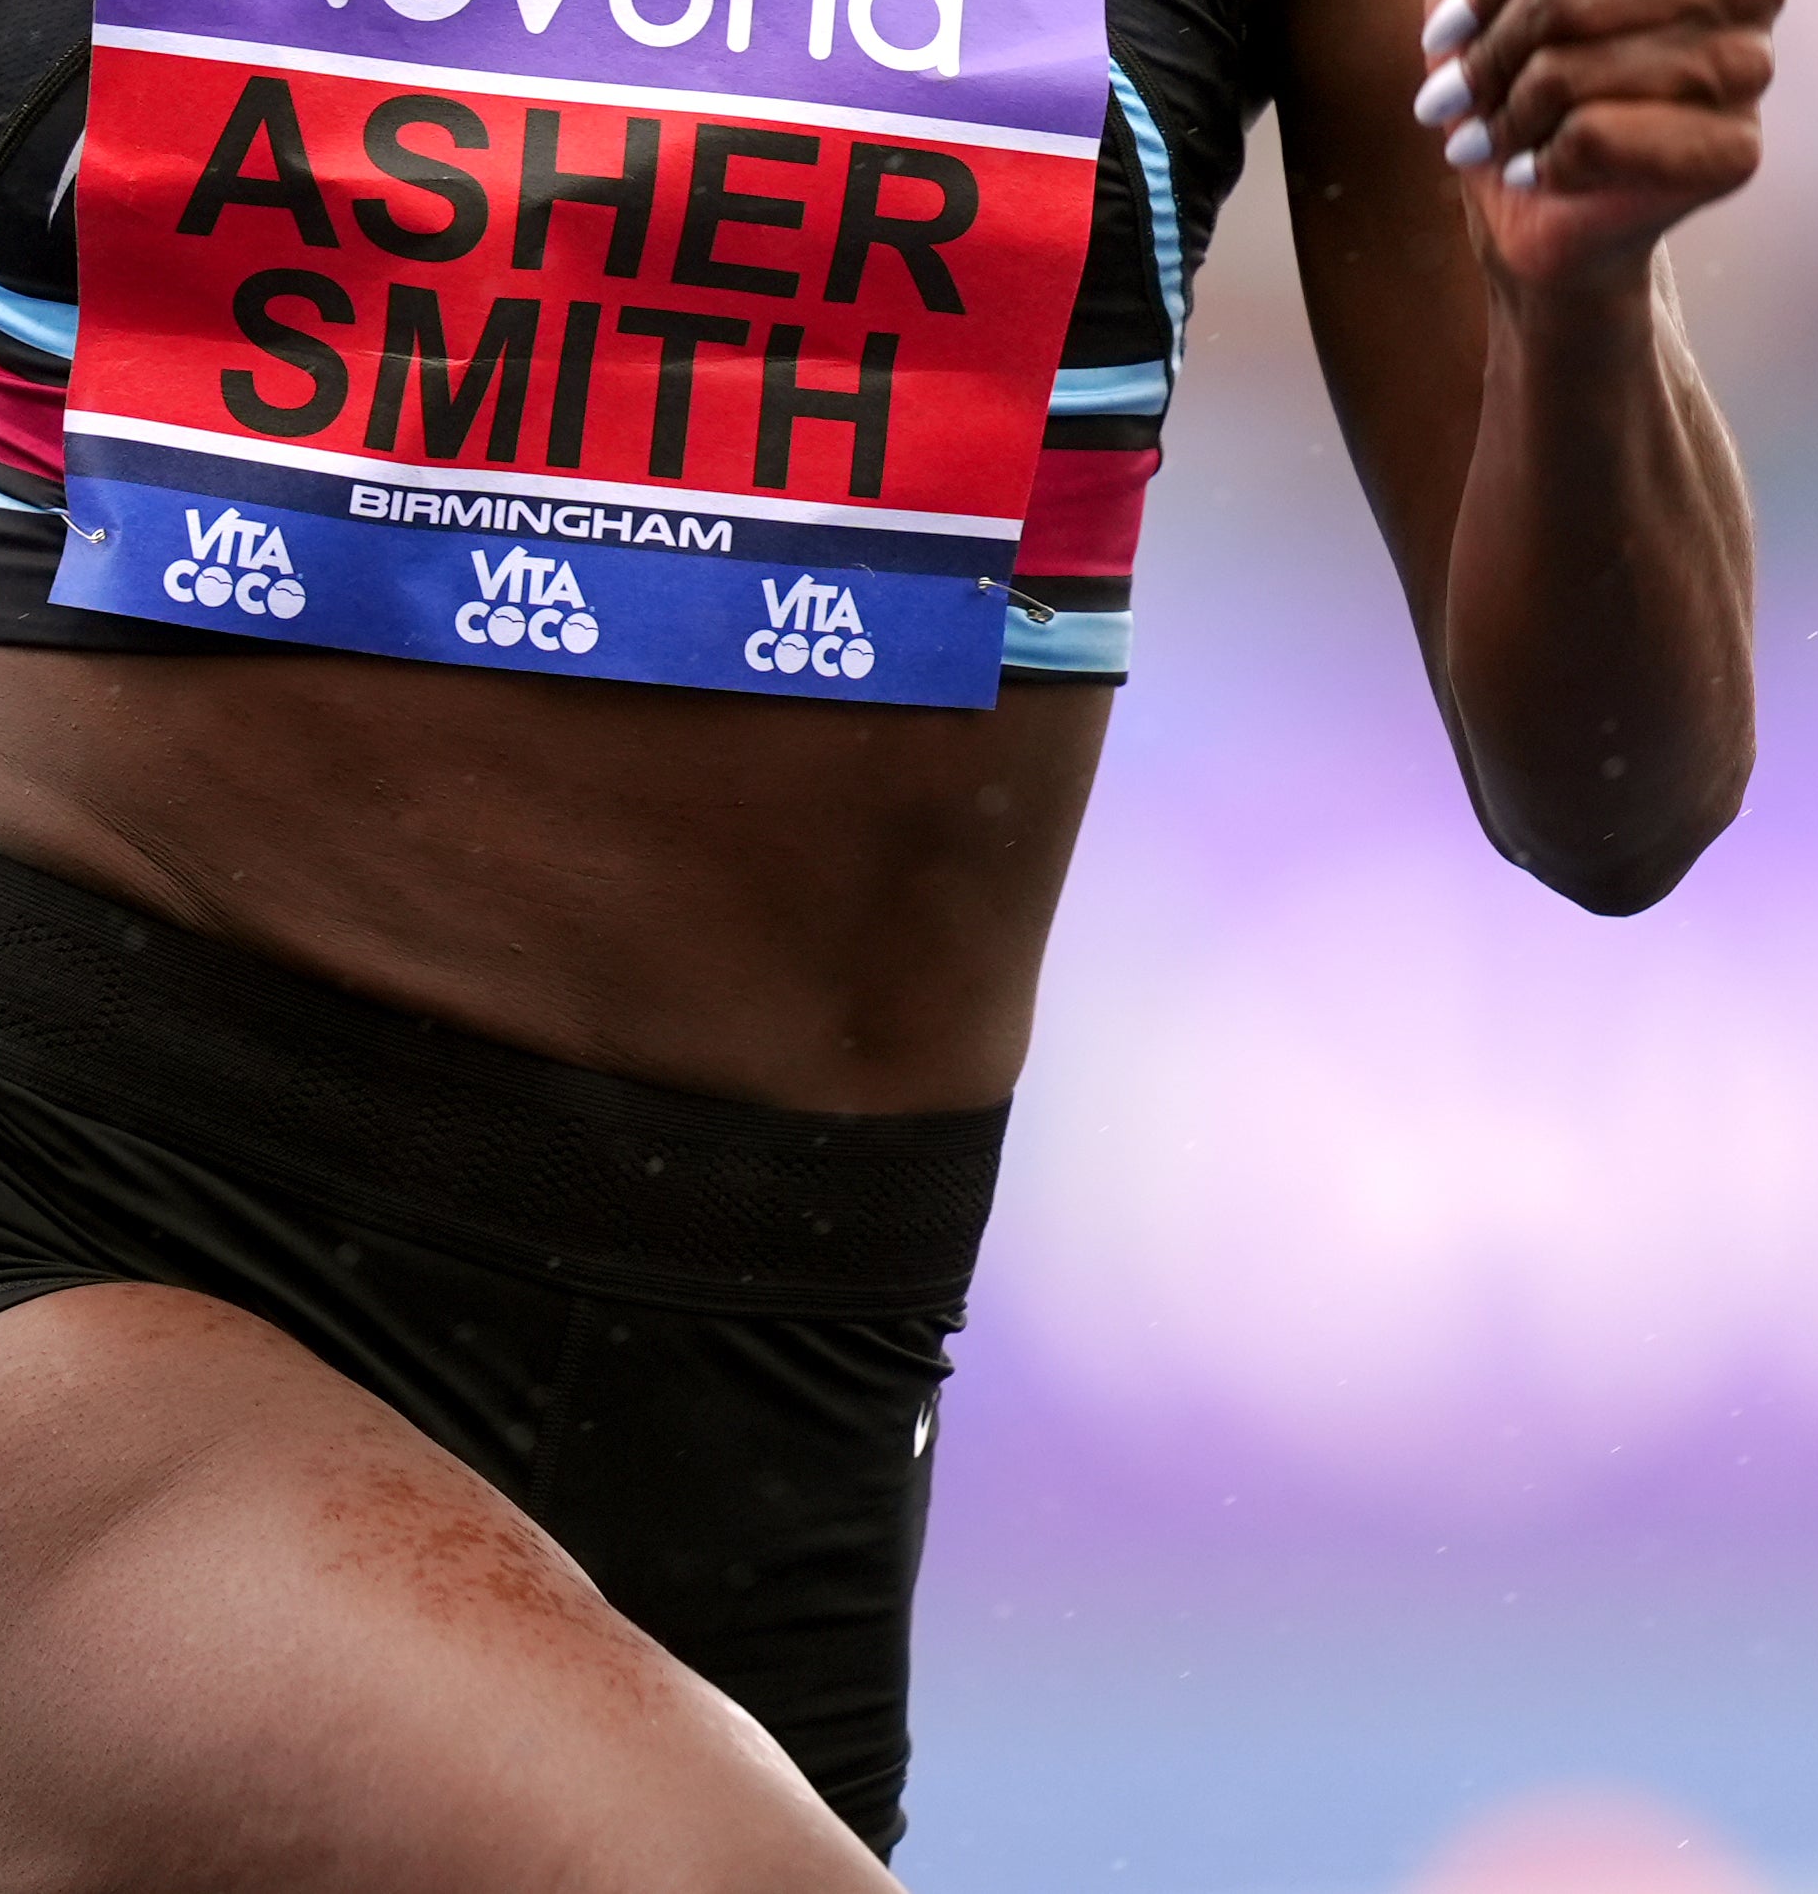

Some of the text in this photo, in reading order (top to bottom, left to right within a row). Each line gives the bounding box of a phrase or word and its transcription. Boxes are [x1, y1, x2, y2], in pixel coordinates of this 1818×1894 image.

[174, 75, 979, 316] ASHER
[220, 266, 902, 500] SMITH
[185, 507, 294, 575] VITA
[349, 484, 733, 552] BIRMINGHAM
[163, 559, 306, 619] COCO
[471, 545, 586, 609] VITA
[761, 573, 864, 635] VITA
[455, 601, 599, 654] COCO
[744, 629, 875, 679] COCO
